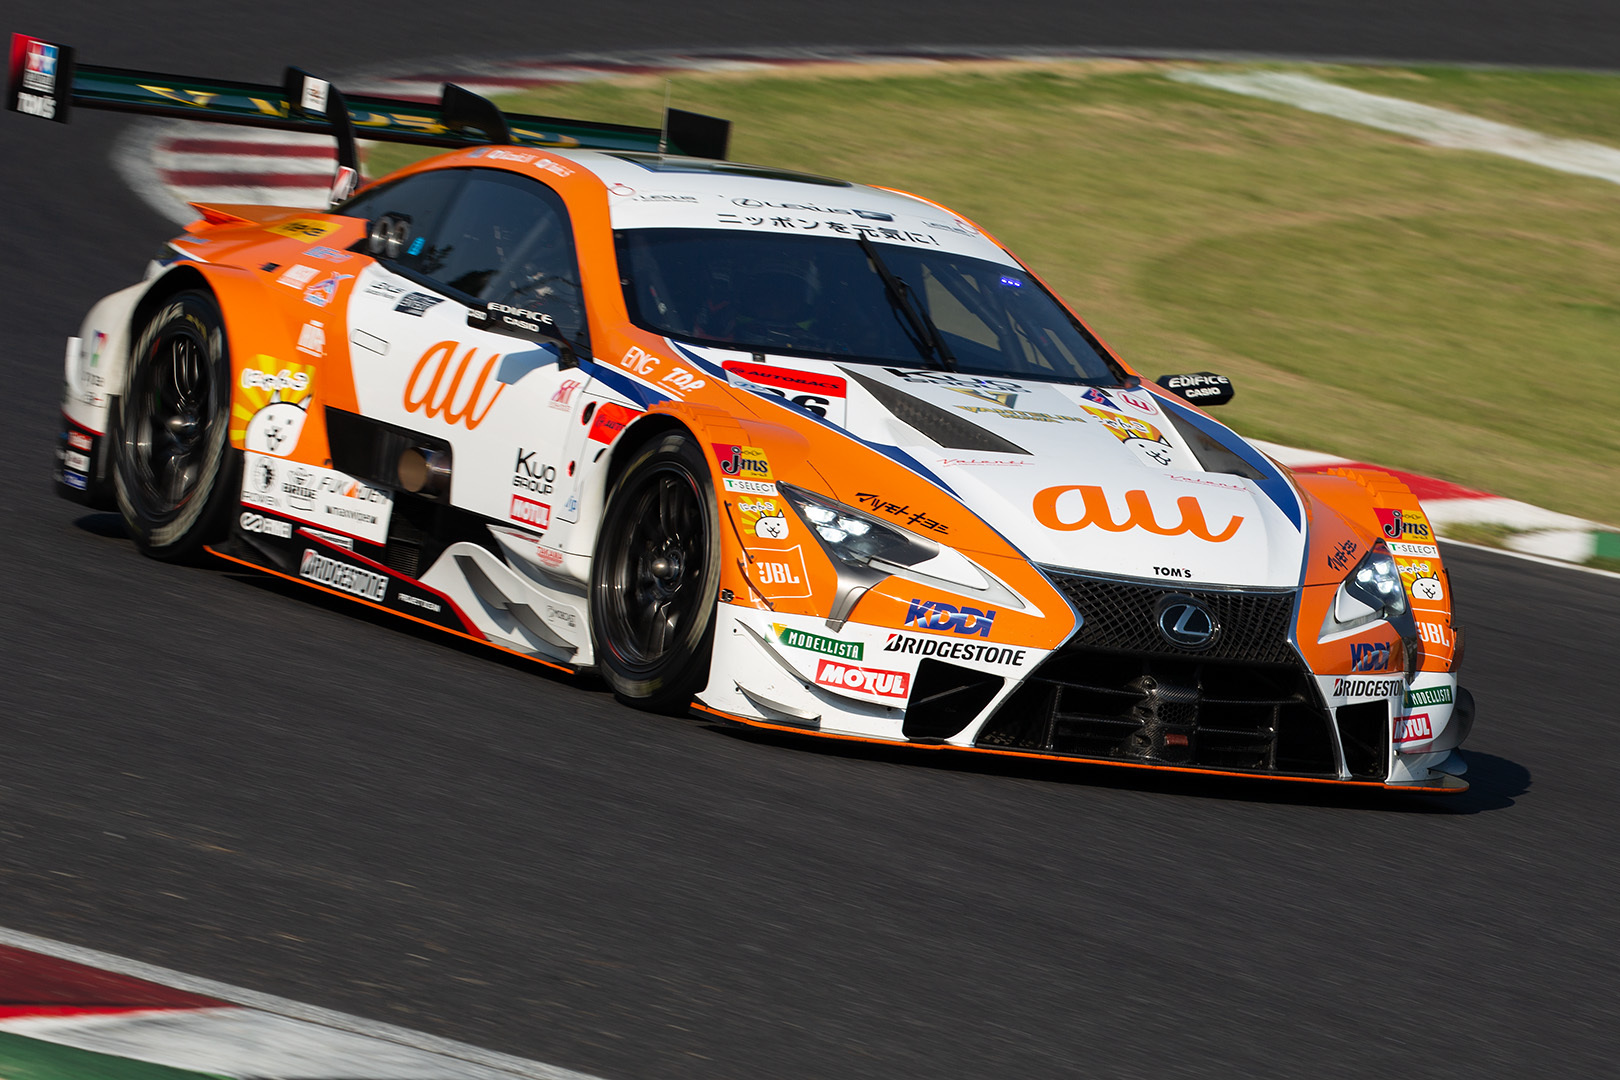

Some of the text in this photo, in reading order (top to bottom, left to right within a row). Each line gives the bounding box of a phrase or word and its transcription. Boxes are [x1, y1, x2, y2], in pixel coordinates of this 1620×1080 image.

[487, 302, 553, 325] EDIFICE
[503, 316, 539, 332] CASIO
[404, 340, 507, 430] au
[748, 371, 840, 389] AUTOBACS
[1168, 374, 1230, 388] EDIFICE
[1185, 387, 1221, 398] CASIO
[721, 446, 769, 474] jms
[725, 479, 775, 492] T-SELECT
[1032, 485, 1244, 543] au
[1383, 509, 1429, 538] jms
[1389, 543, 1437, 555] T-SELECT
[758, 562, 800, 585] JBL
[1152, 566, 1192, 579] TOM'S
[904, 598, 996, 638] KDDI
[787, 630, 860, 660] MODELLISTA
[1416, 621, 1451, 648] JBL
[883, 633, 1027, 667] BRIDGESTONE
[1350, 642, 1391, 672] KDDI
[818, 663, 905, 696] MOTUL
[1411, 688, 1451, 706] MODELLISTA
